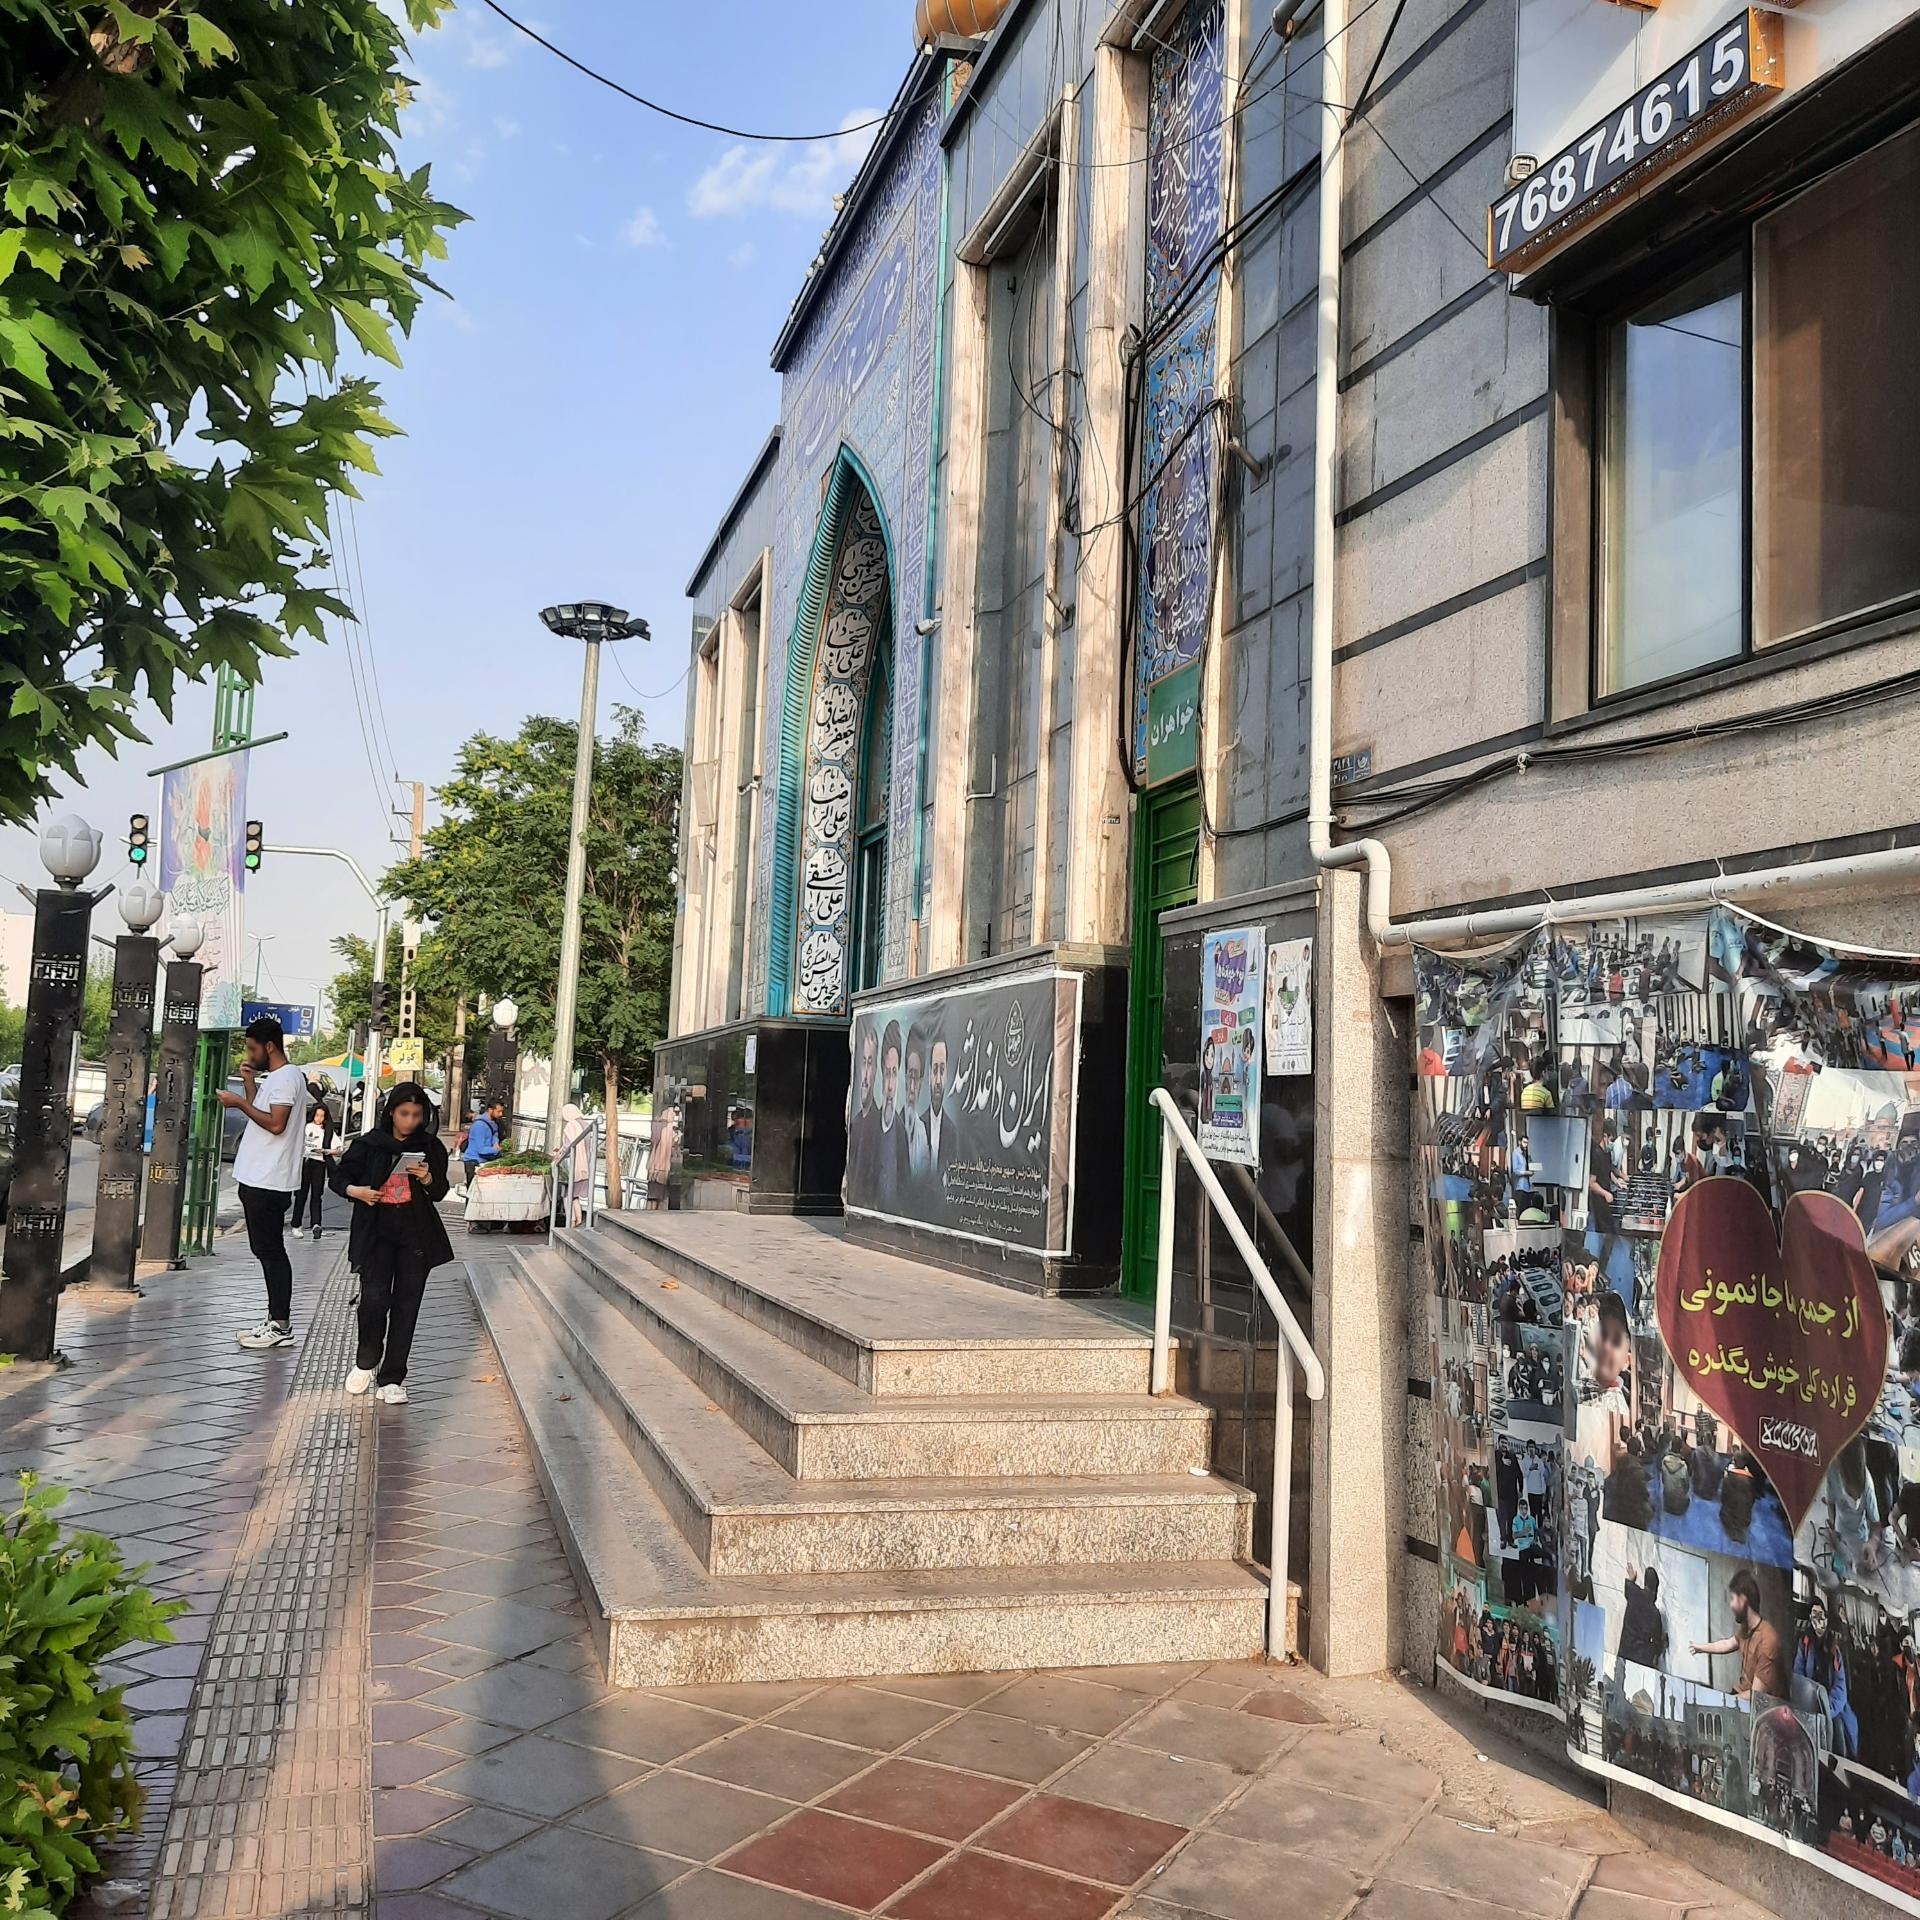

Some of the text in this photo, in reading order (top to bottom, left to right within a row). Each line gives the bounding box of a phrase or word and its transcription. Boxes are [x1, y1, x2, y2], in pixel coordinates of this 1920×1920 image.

[1493, 25, 1745, 253] 76874615
[1150, 699, 1195, 747] خواهران
[397, 1052, 416, 1065] کولر
[947, 1018, 976, 1098] شد
[962, 1034, 1002, 1120] داغدار
[1000, 1041, 1054, 1154] ایران
[1679, 1268, 1860, 1339] از جمع ما جا نمونی
[1687, 1343, 1858, 1418] قراره کلی خوش بگذره
